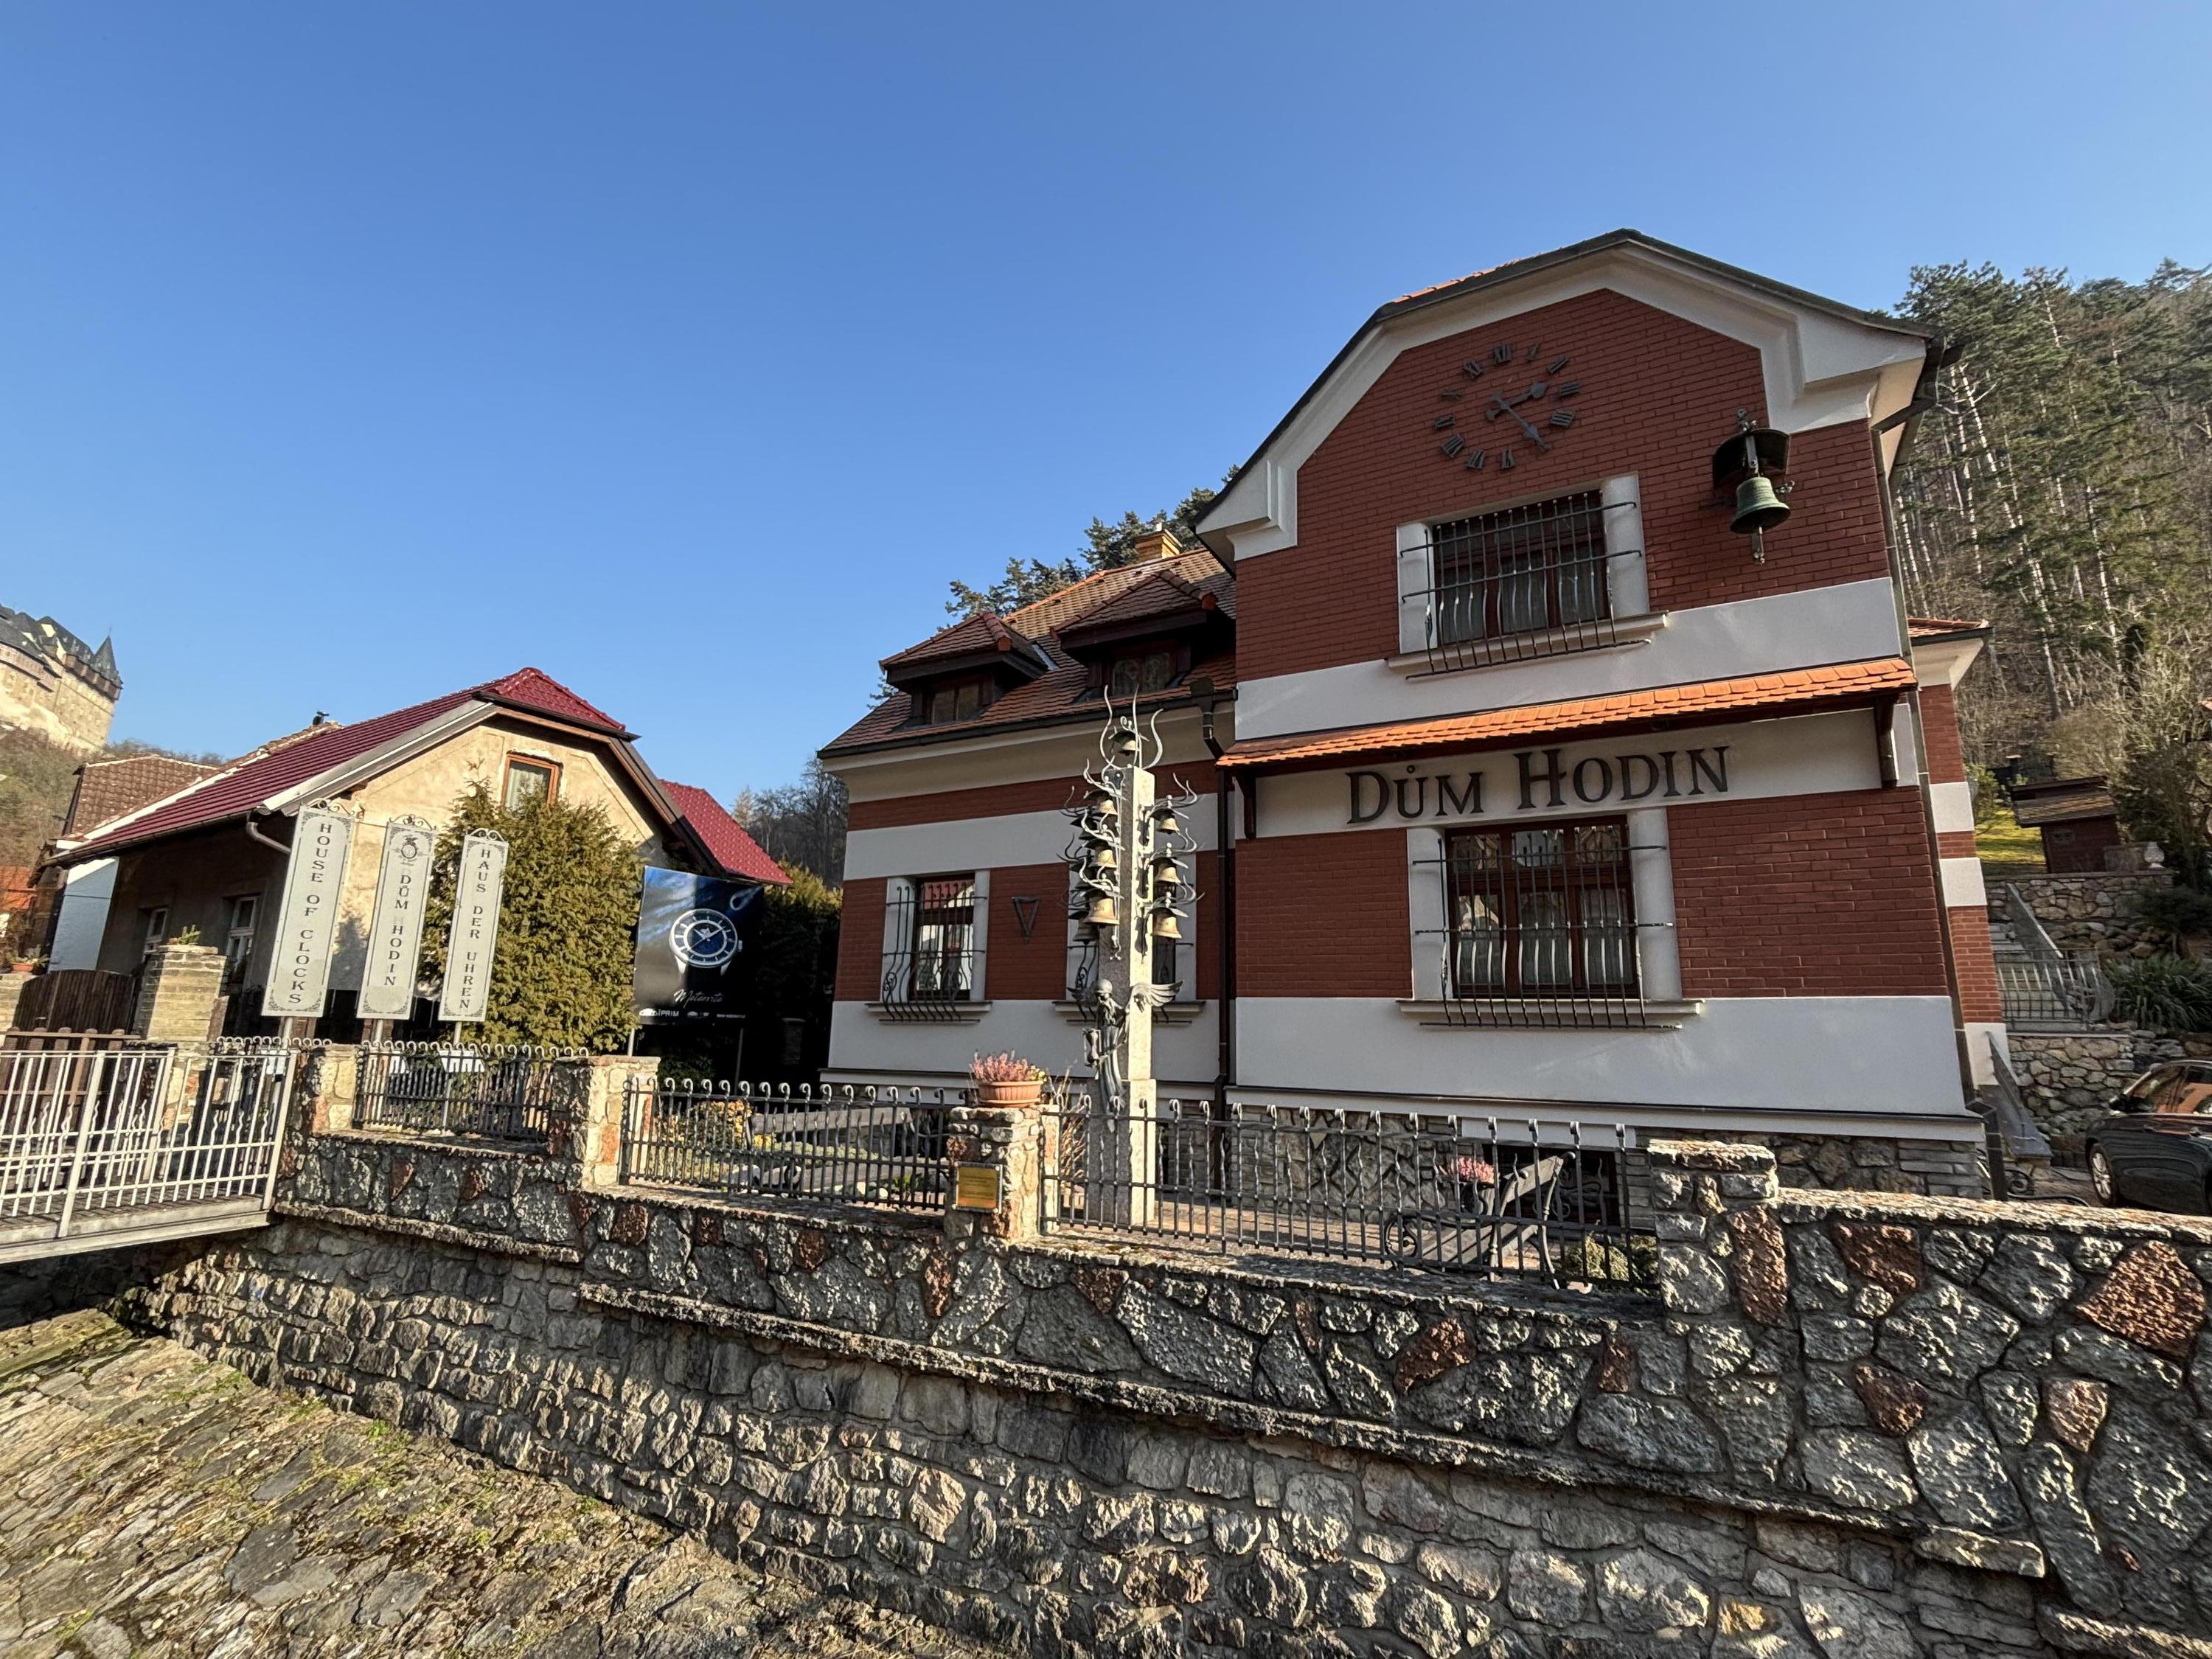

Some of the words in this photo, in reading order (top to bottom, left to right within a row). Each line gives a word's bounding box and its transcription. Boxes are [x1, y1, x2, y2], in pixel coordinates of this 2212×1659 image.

[1512, 745, 1730, 810] HODIN
[312, 823, 332, 883] HOUSE
[476, 849, 490, 894] HAUS
[304, 894, 320, 917] OF
[394, 874, 411, 910] DŮM
[470, 905, 484, 939] DER
[288, 930, 313, 1004] CLOCKS
[384, 925, 403, 986] HODIN
[459, 952, 476, 1009] UHREN
